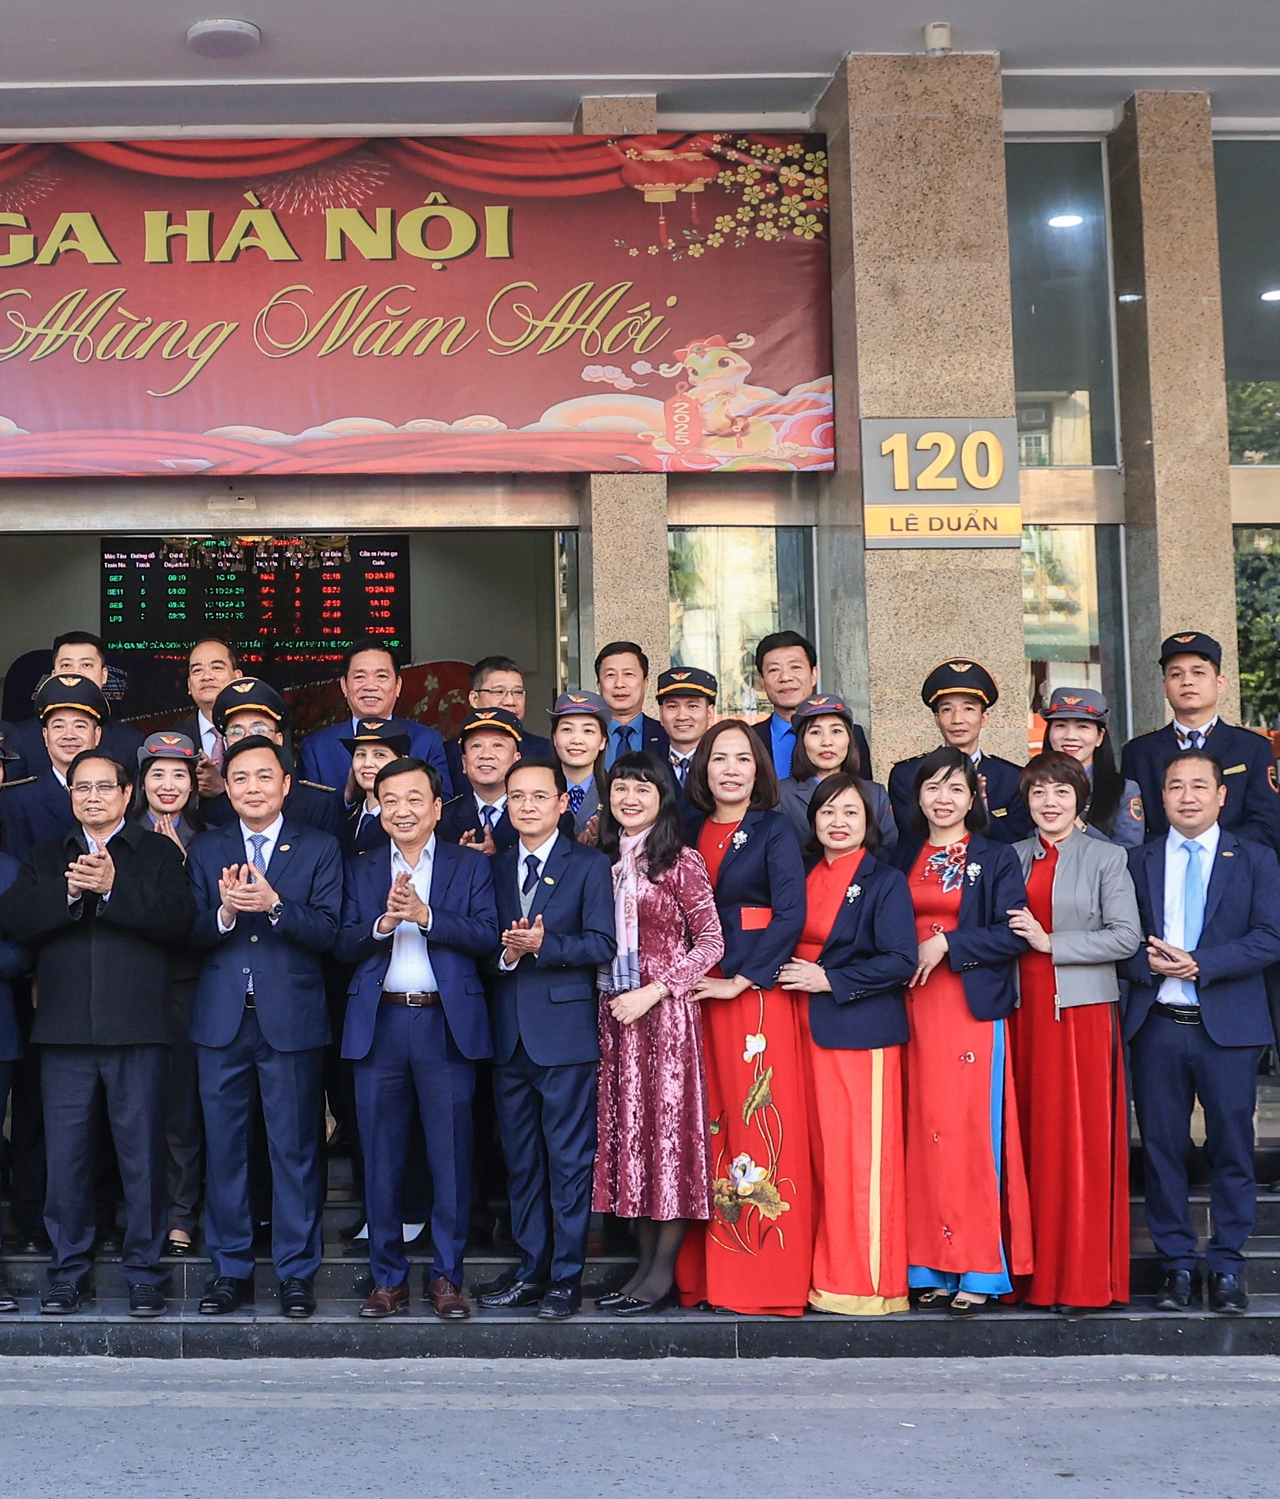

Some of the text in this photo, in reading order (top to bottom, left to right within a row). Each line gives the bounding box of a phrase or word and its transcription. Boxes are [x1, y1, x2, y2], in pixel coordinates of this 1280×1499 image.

[144, 191, 300, 263] HÀ
[325, 191, 513, 271] NỘI
[253, 284, 481, 359] Năm
[486, 281, 677, 357] Mới
[672, 402, 691, 446] 2025
[881, 430, 1005, 490] 120
[890, 509, 998, 532] LÊ DUẨN
